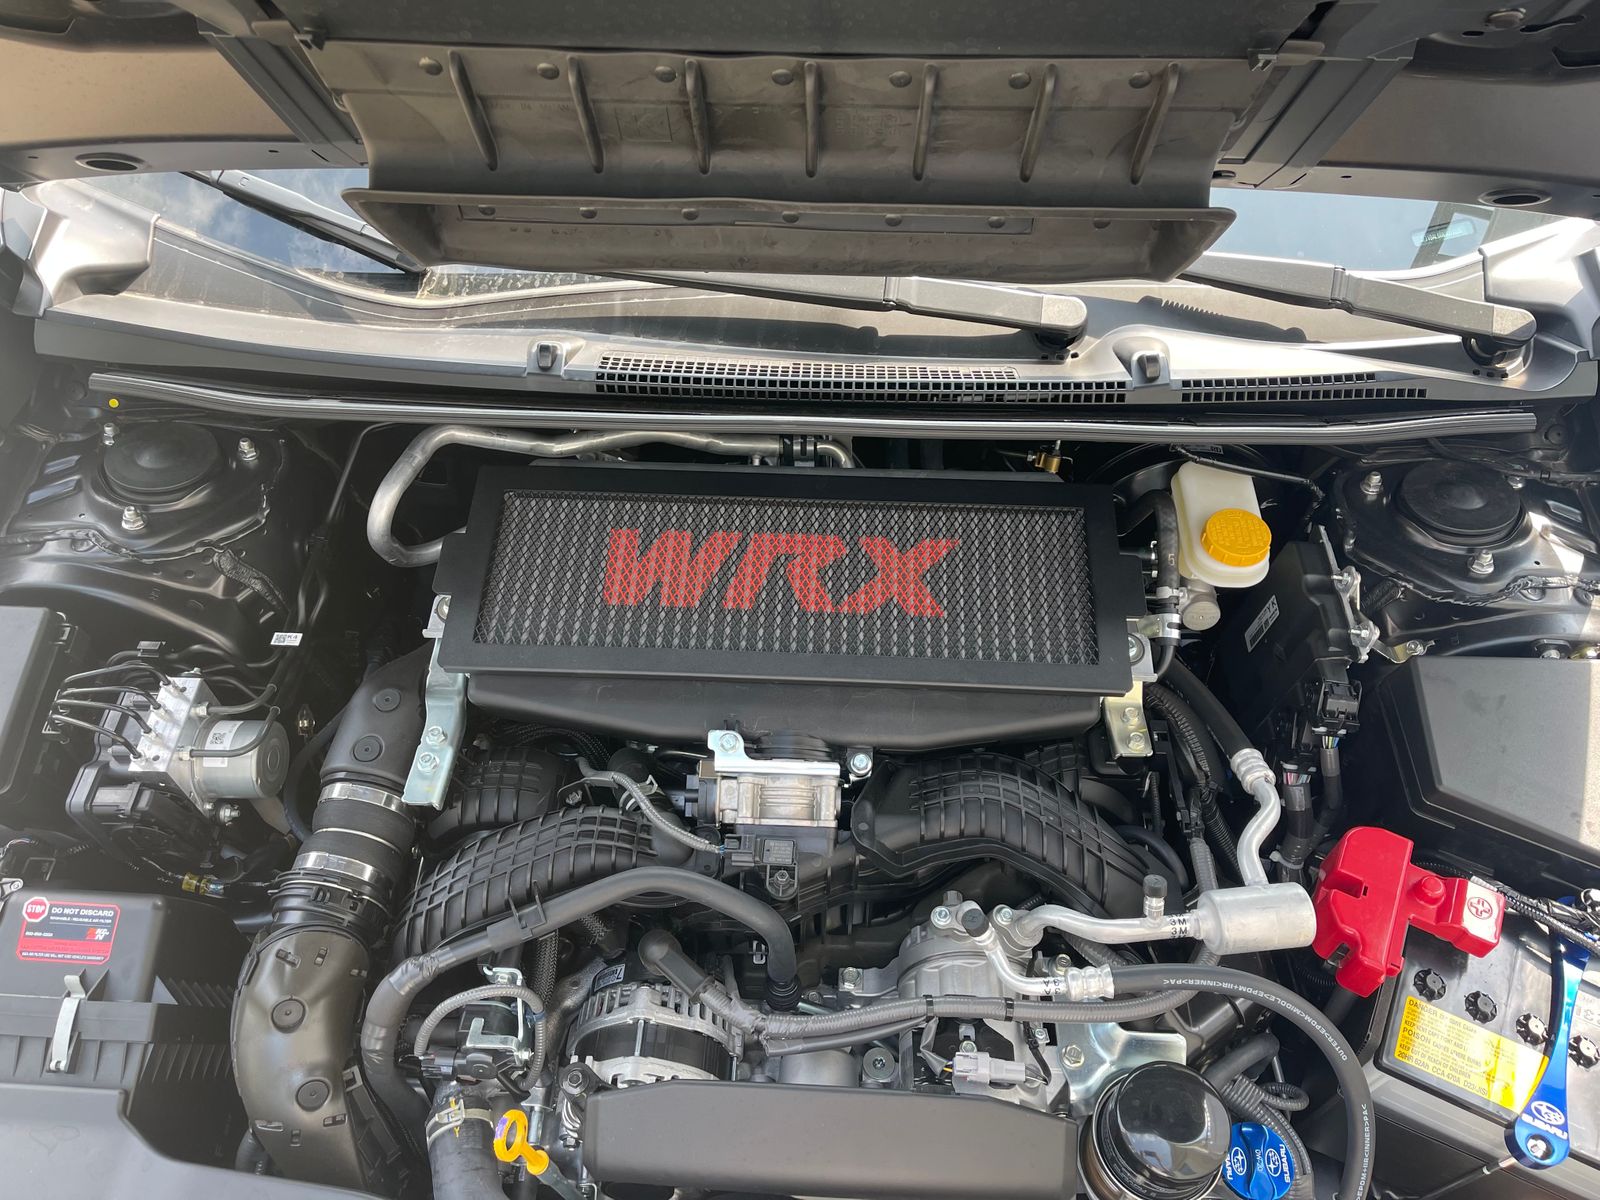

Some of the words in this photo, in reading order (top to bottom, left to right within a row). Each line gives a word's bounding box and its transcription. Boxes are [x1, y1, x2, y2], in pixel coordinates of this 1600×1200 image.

[603, 527, 961, 618] WRX
[27, 904, 46, 913] STOP
[80, 909, 114, 917] DISCARD
[1171, 927, 1188, 935] 3M
[1402, 1026, 1431, 1045] POISON
[1431, 1065, 1445, 1078] CCA
[1521, 1113, 1569, 1141] SUBARU
[1279, 1143, 1290, 1183] SUBARU
